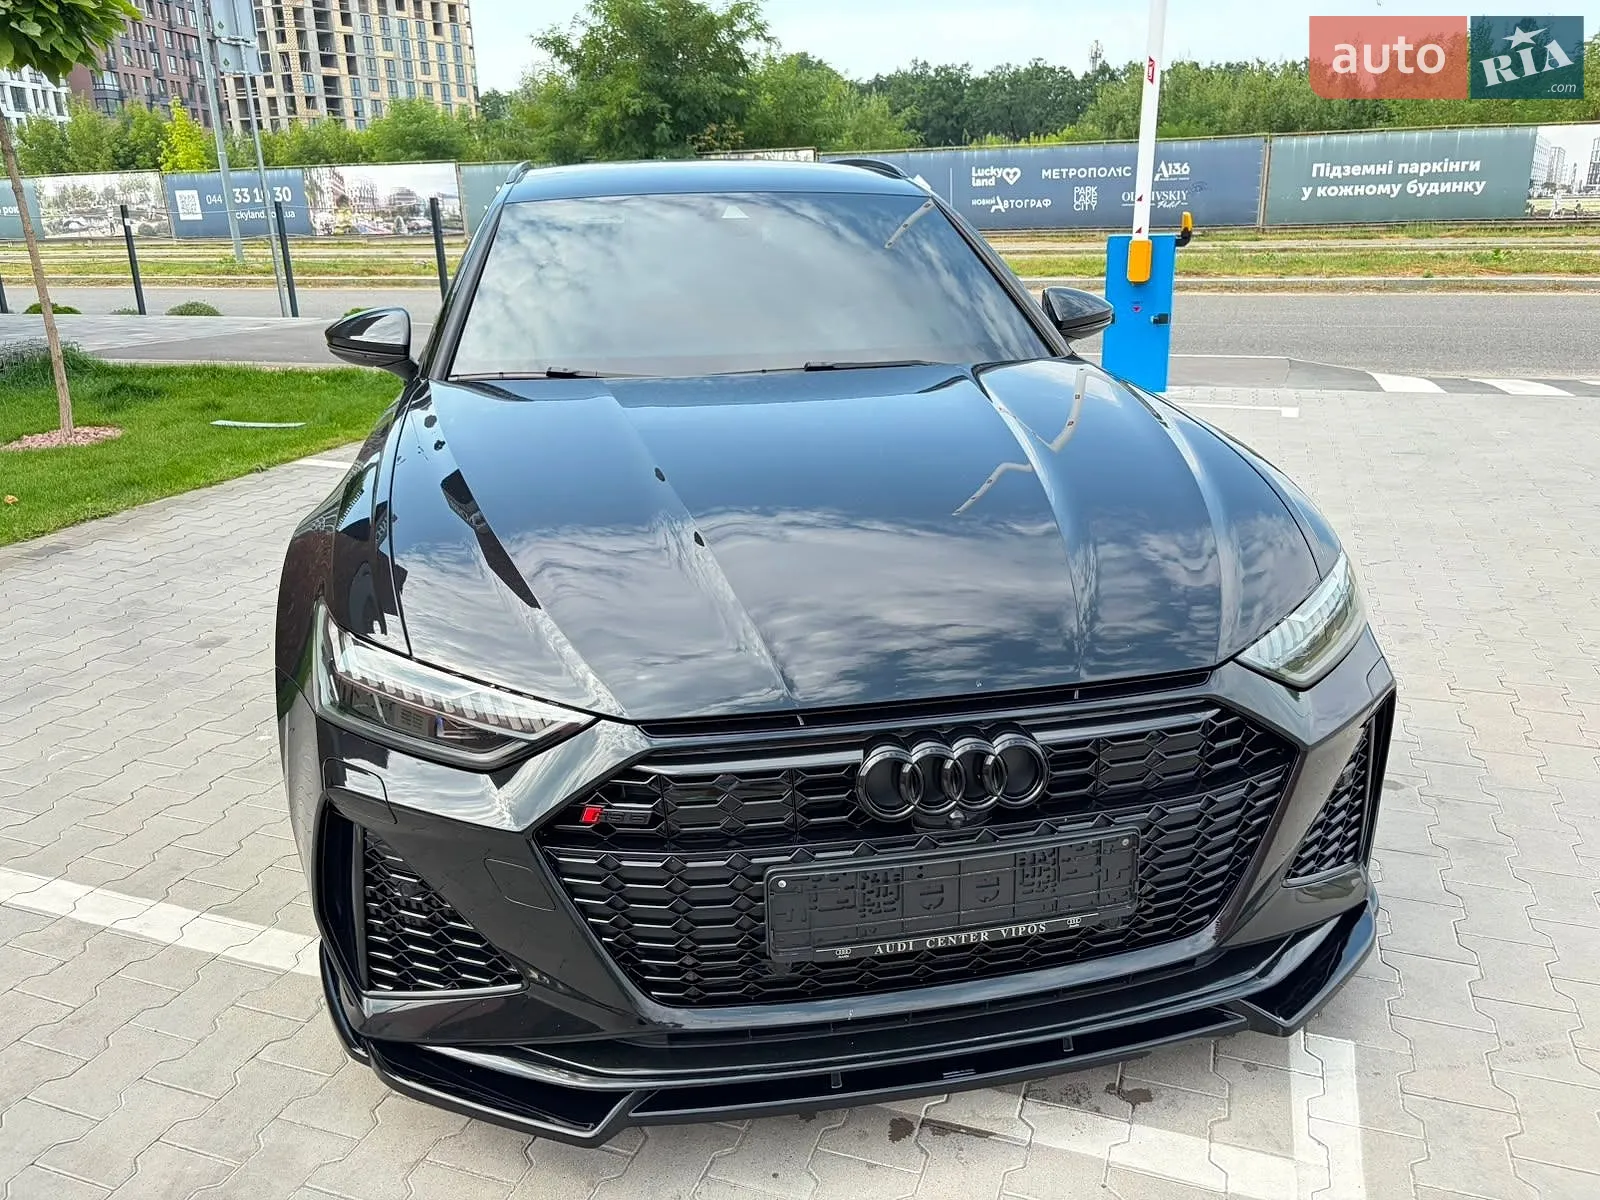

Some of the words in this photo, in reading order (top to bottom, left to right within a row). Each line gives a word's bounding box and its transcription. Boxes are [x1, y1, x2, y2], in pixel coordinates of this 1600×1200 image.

[971, 165, 1003, 178] Lucky
[1311, 160, 1394, 179] Підземні
[1397, 158, 1482, 177] паркінги
[971, 176, 996, 187] land
[1300, 186, 1313, 201] у
[1316, 182, 1403, 198] кожному
[1406, 178, 1487, 197] будинку
[205, 194, 223, 205] 044
[272, 186, 292, 202] 30
[874, 940, 914, 955] AUDI
[925, 931, 990, 949] CENTER
[1000, 922, 1047, 939] VIPOS
